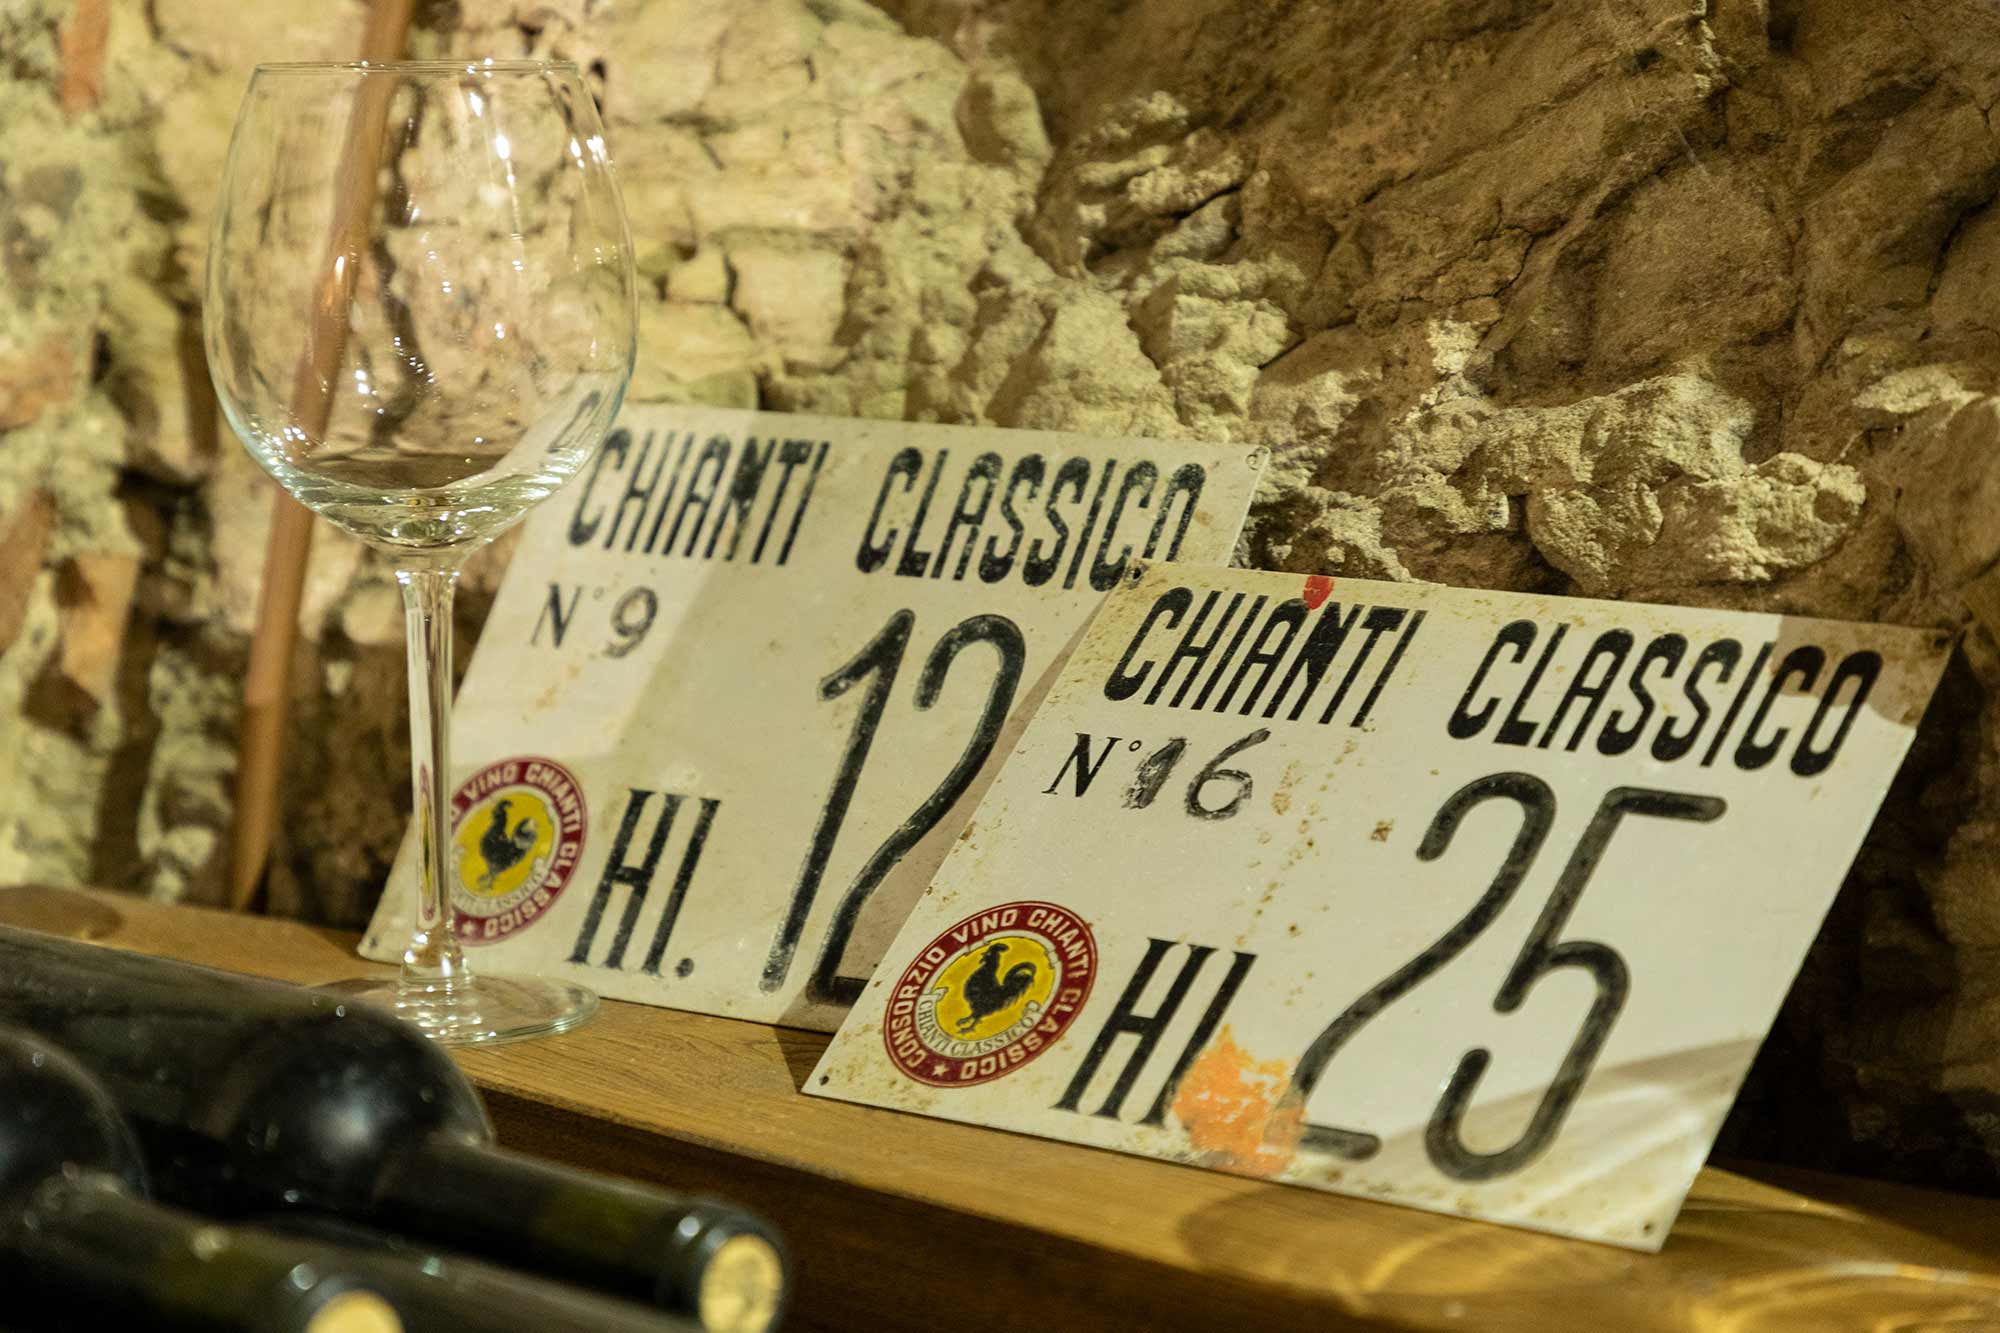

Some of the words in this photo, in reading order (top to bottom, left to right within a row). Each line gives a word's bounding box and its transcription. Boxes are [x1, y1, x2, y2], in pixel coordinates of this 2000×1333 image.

[567, 428, 830, 567] CHIANTI
[855, 446, 1206, 592] CLASSICO
[601, 586, 659, 659] 9
[1103, 586, 1429, 728] CHIANTI
[1447, 618, 1883, 777] CLASSICO
[464, 762, 519, 801] VINO
[525, 763, 581, 833] CHIANTI
[757, 608, 1026, 1004] 12
[483, 843, 578, 938] CLASSICO
[952, 908, 1018, 944] VINO
[1027, 908, 1089, 979] CHIANTI
[1270, 771, 1727, 1182] 25
[891, 946, 945, 1068] CONSORZIO
[917, 998, 949, 1052] CHIANTI
[951, 1015, 1036, 1057] CLASSICO
[959, 987, 1082, 1080] CLASSICO
